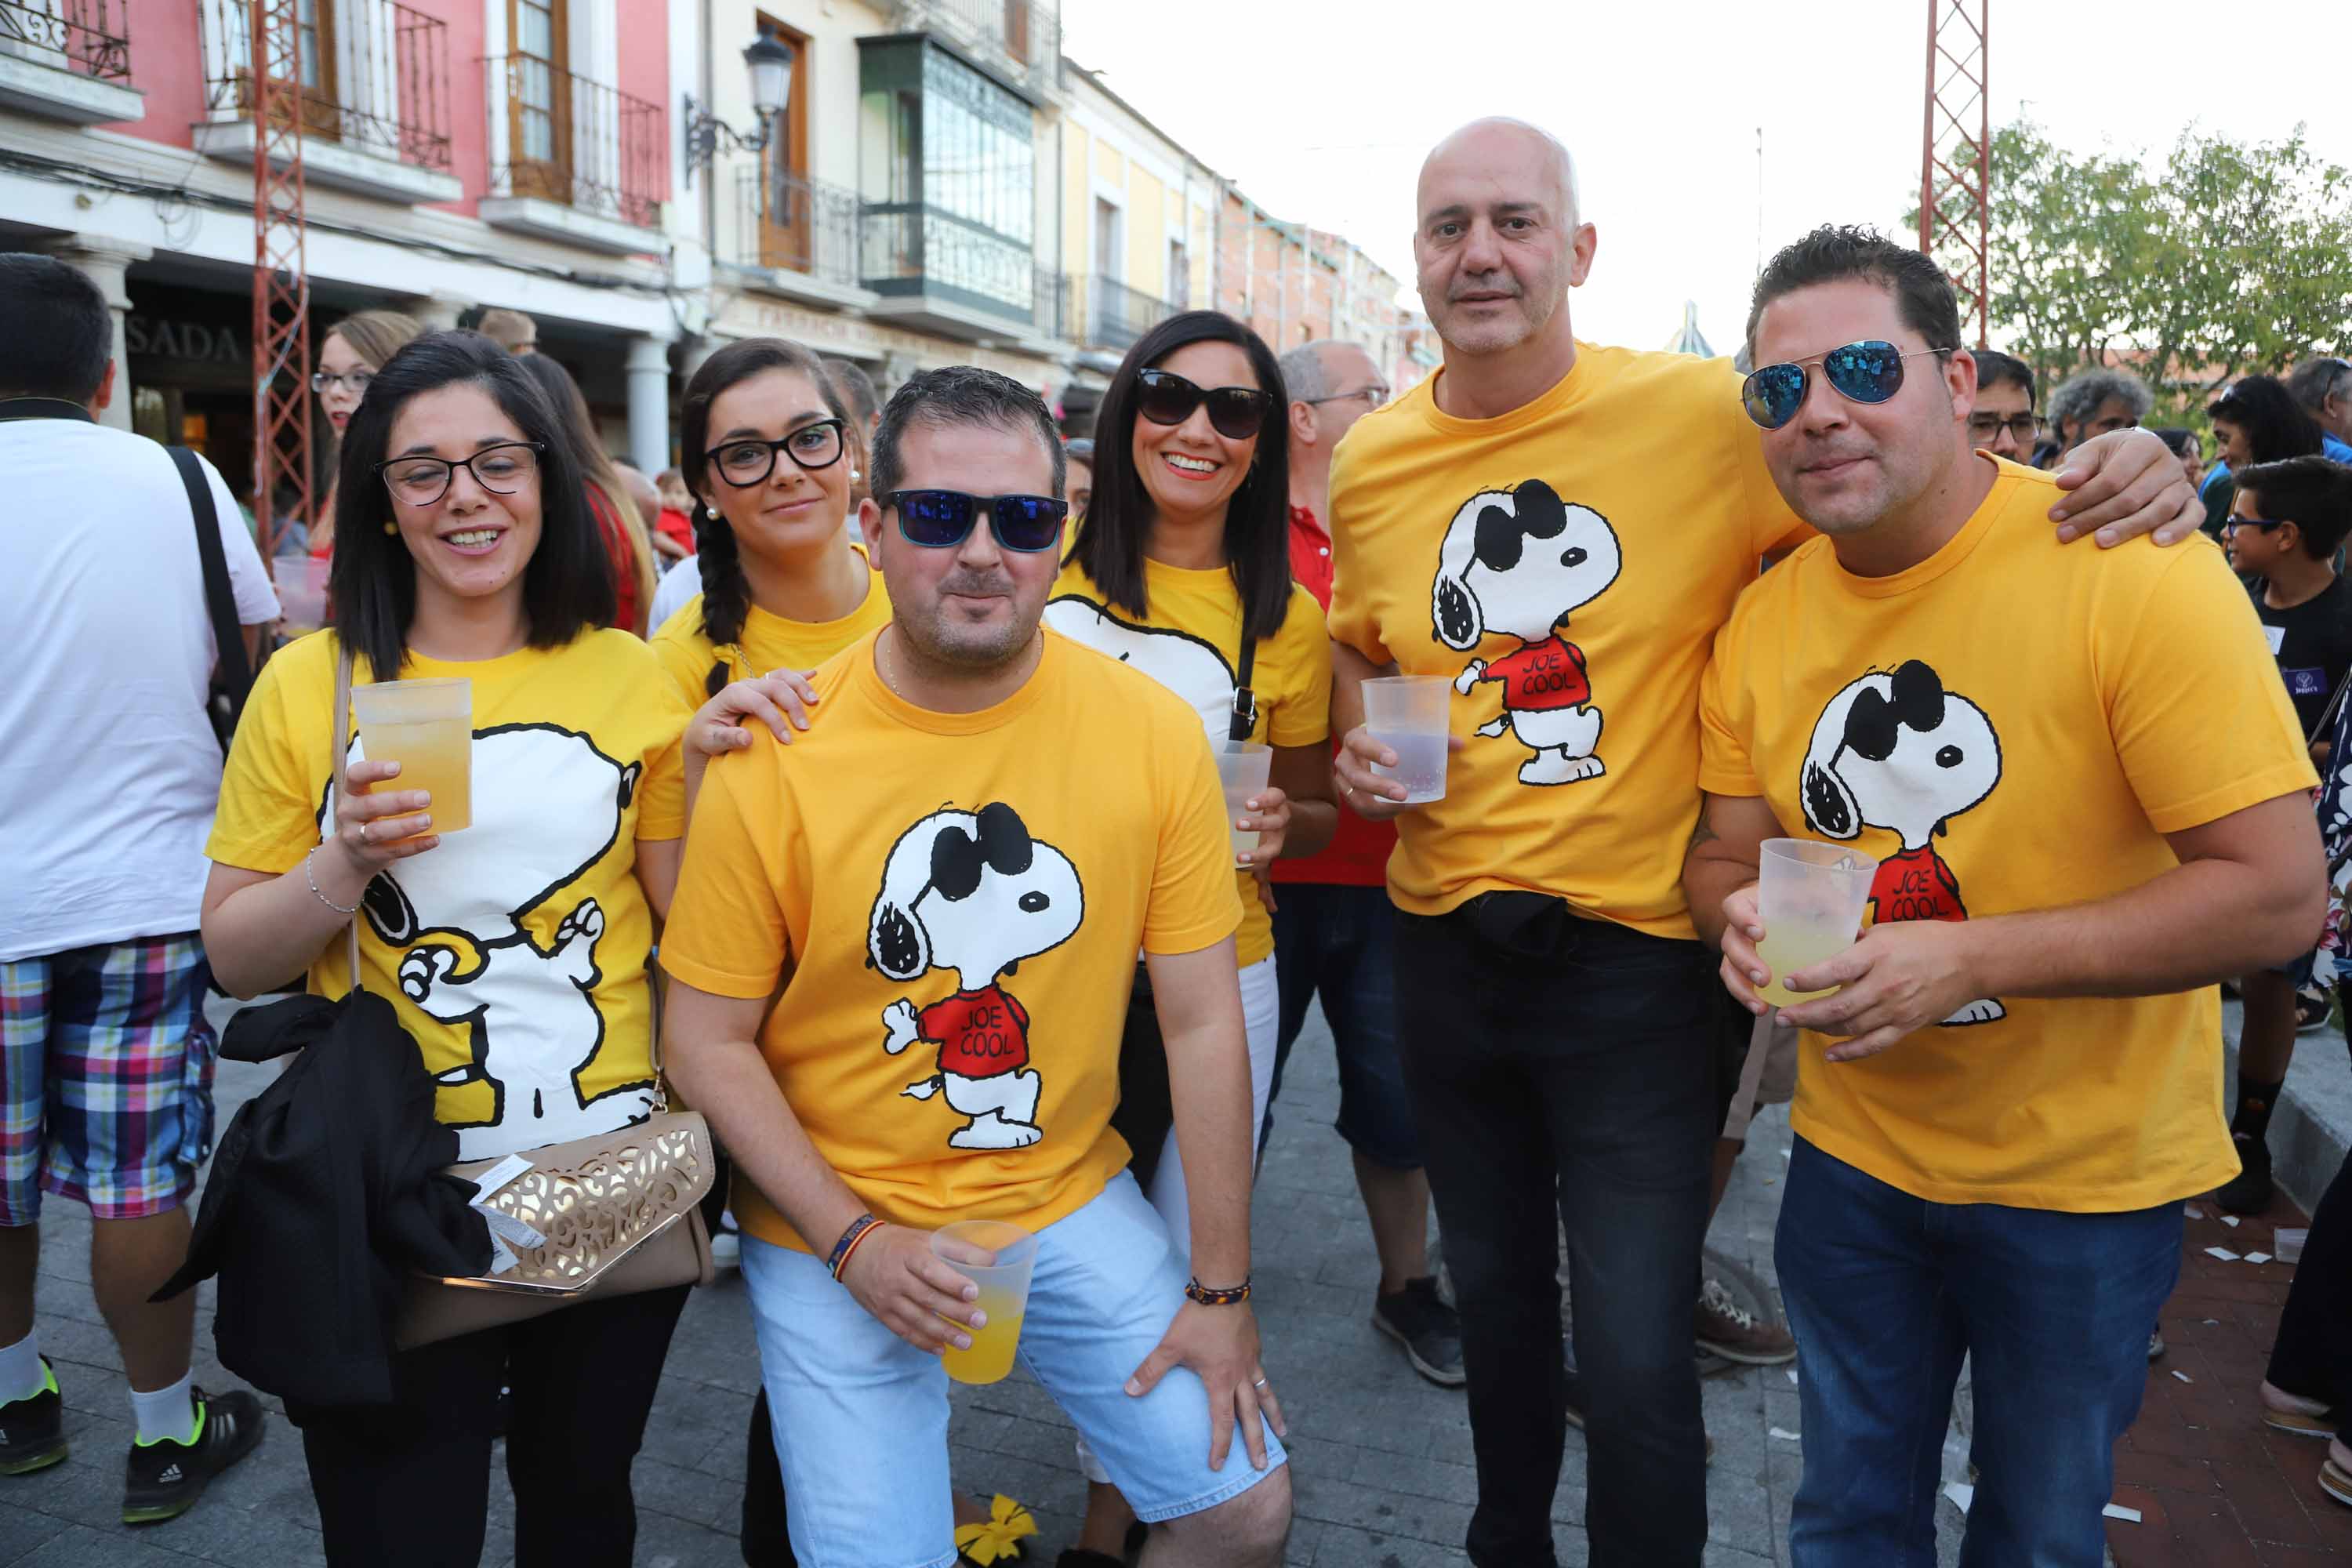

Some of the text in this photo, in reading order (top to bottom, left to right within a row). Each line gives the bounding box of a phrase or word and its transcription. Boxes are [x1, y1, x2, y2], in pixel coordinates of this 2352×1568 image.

[1523, 653, 1562, 673] JOE
[1523, 672, 1577, 695] COOL
[1893, 869, 1930, 894] JOE
[1892, 897, 1950, 921] COOL
[961, 1006, 1002, 1031] JOE
[960, 1032, 1015, 1058] COOL
